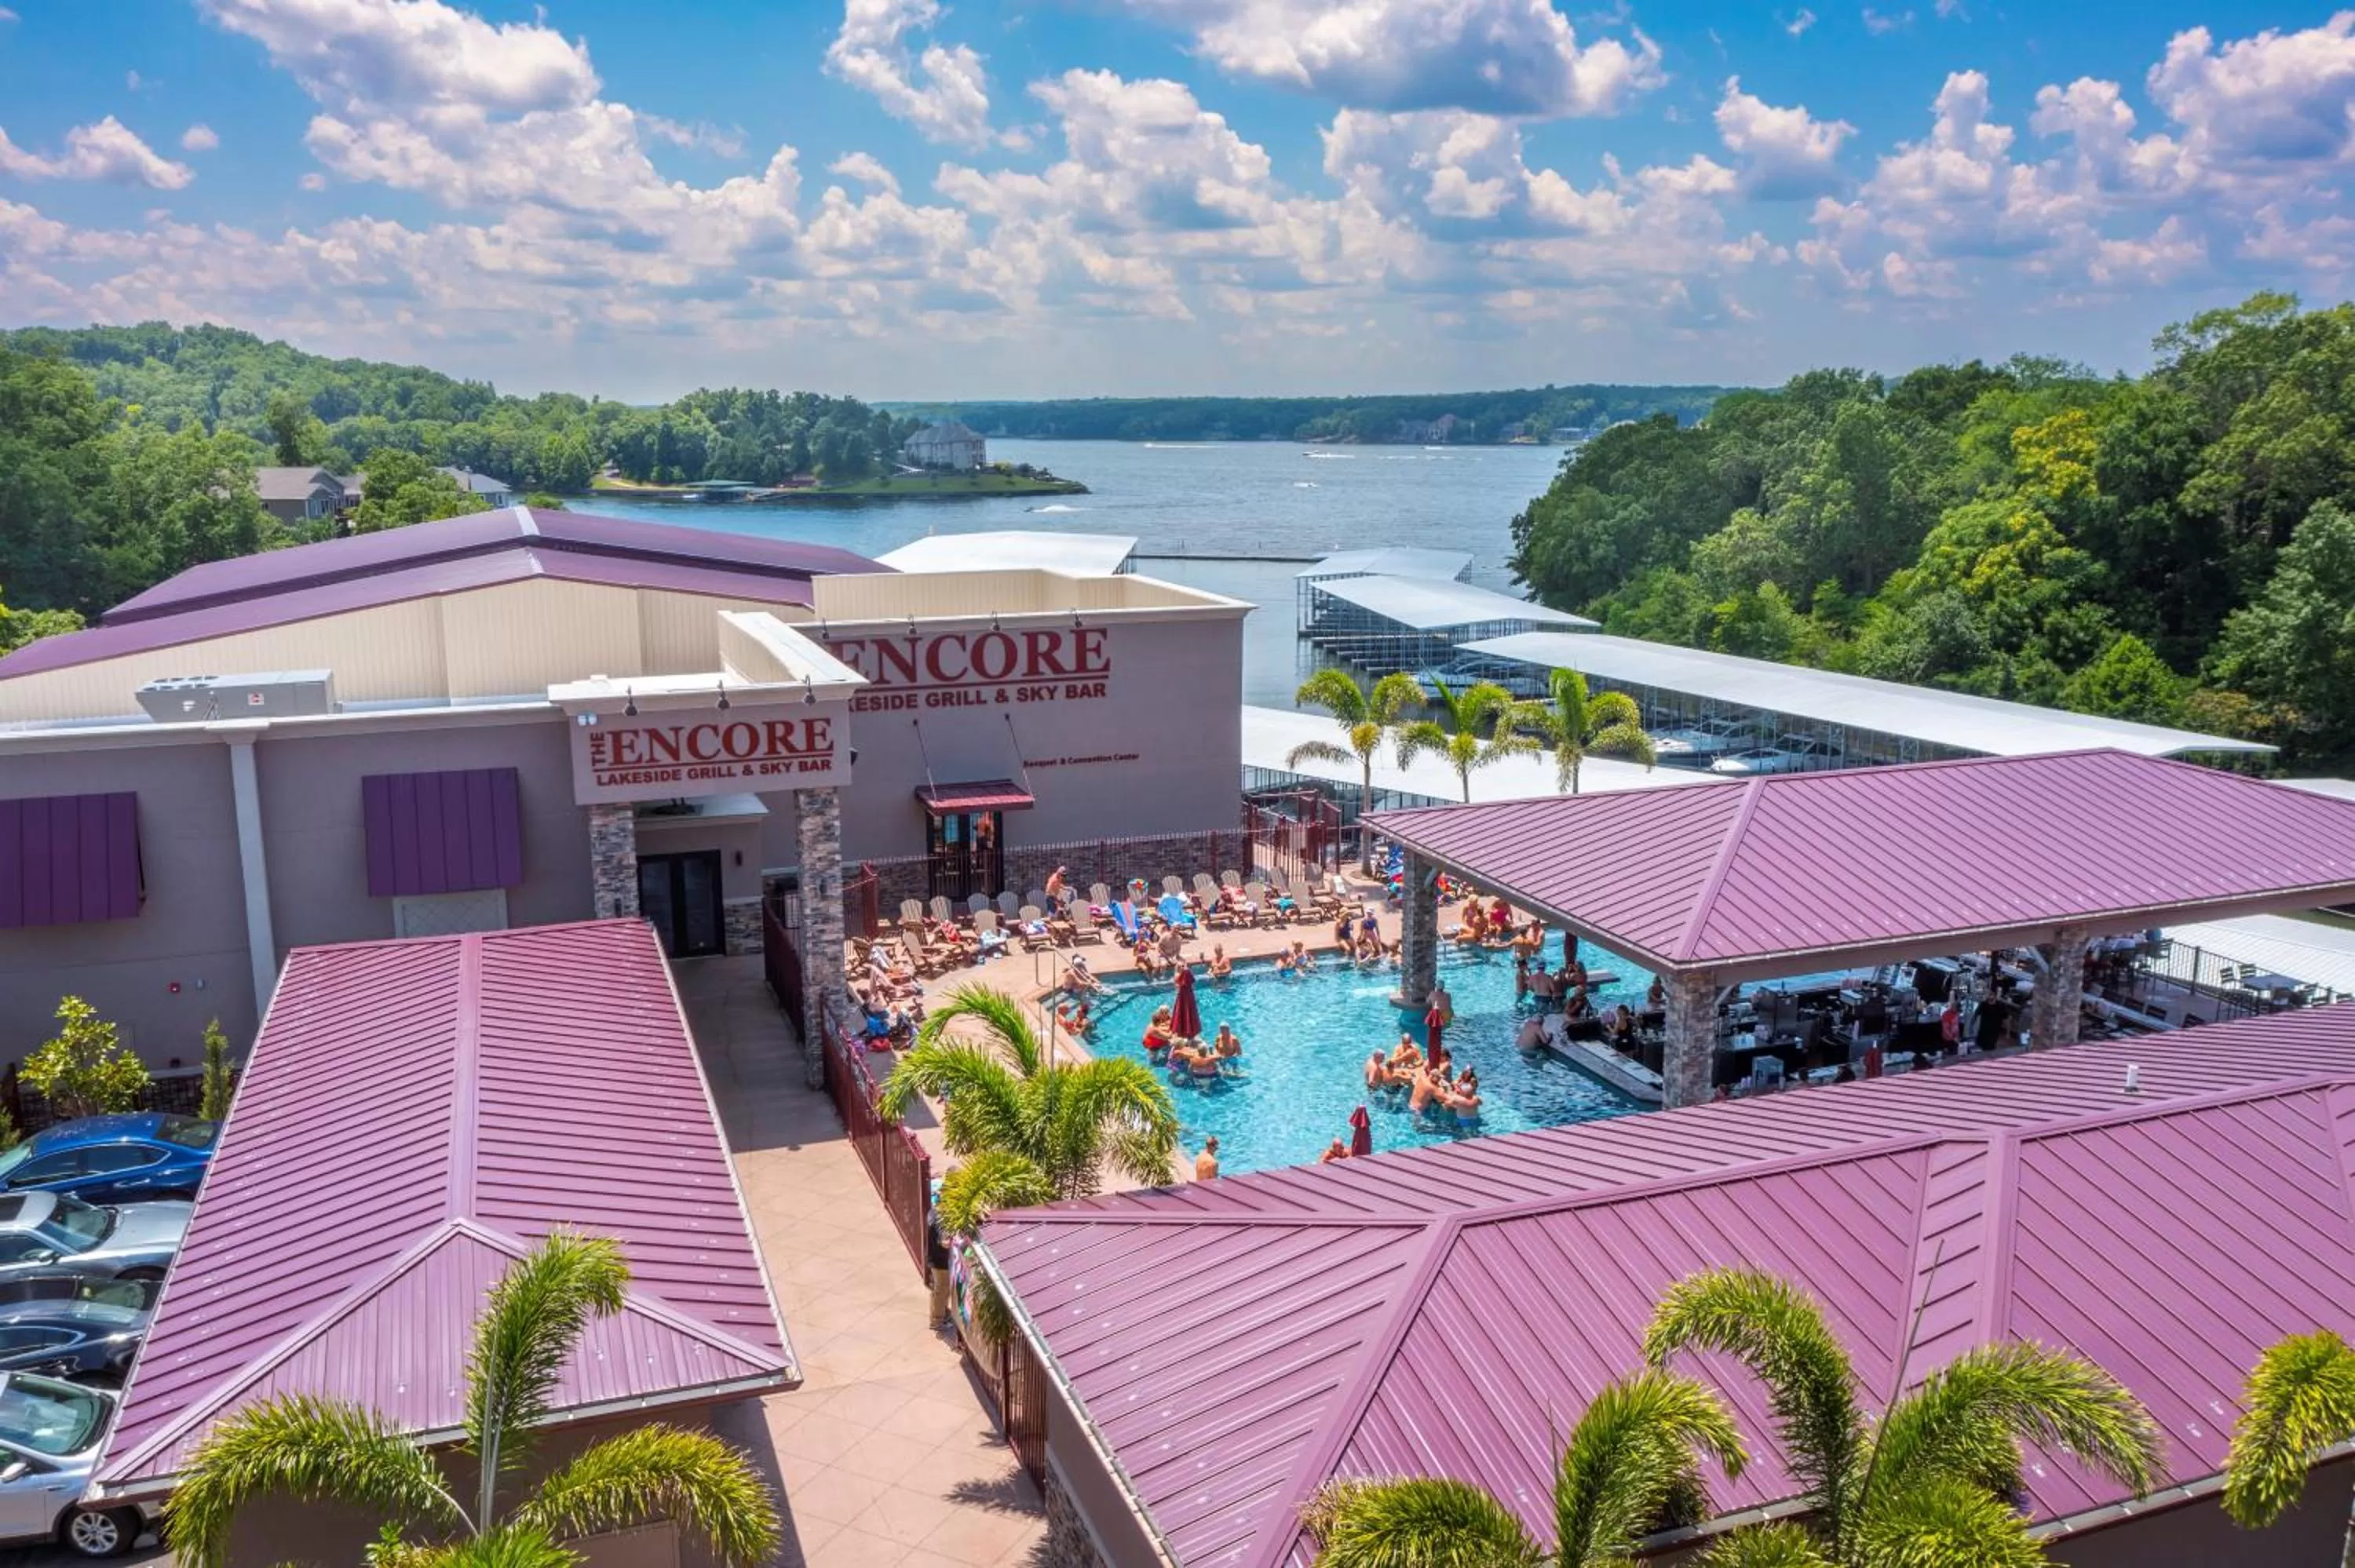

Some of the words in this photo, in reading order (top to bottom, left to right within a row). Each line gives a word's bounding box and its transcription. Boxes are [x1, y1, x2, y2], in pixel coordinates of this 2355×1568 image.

[824, 628, 1111, 684] ENCORE
[849, 693, 918, 713] ESIDE
[926, 690, 988, 708] GRILL
[995, 687, 1010, 704] &
[1017, 685, 1058, 702] SKY
[1065, 682, 1107, 699] BAR
[590, 731, 607, 767] THE
[606, 717, 835, 767] ENCORE
[597, 768, 682, 787] LAKESIDE
[688, 765, 737, 781] GRILL
[742, 763, 754, 776] &
[759, 760, 792, 775] SKY
[798, 758, 832, 772] BAR
